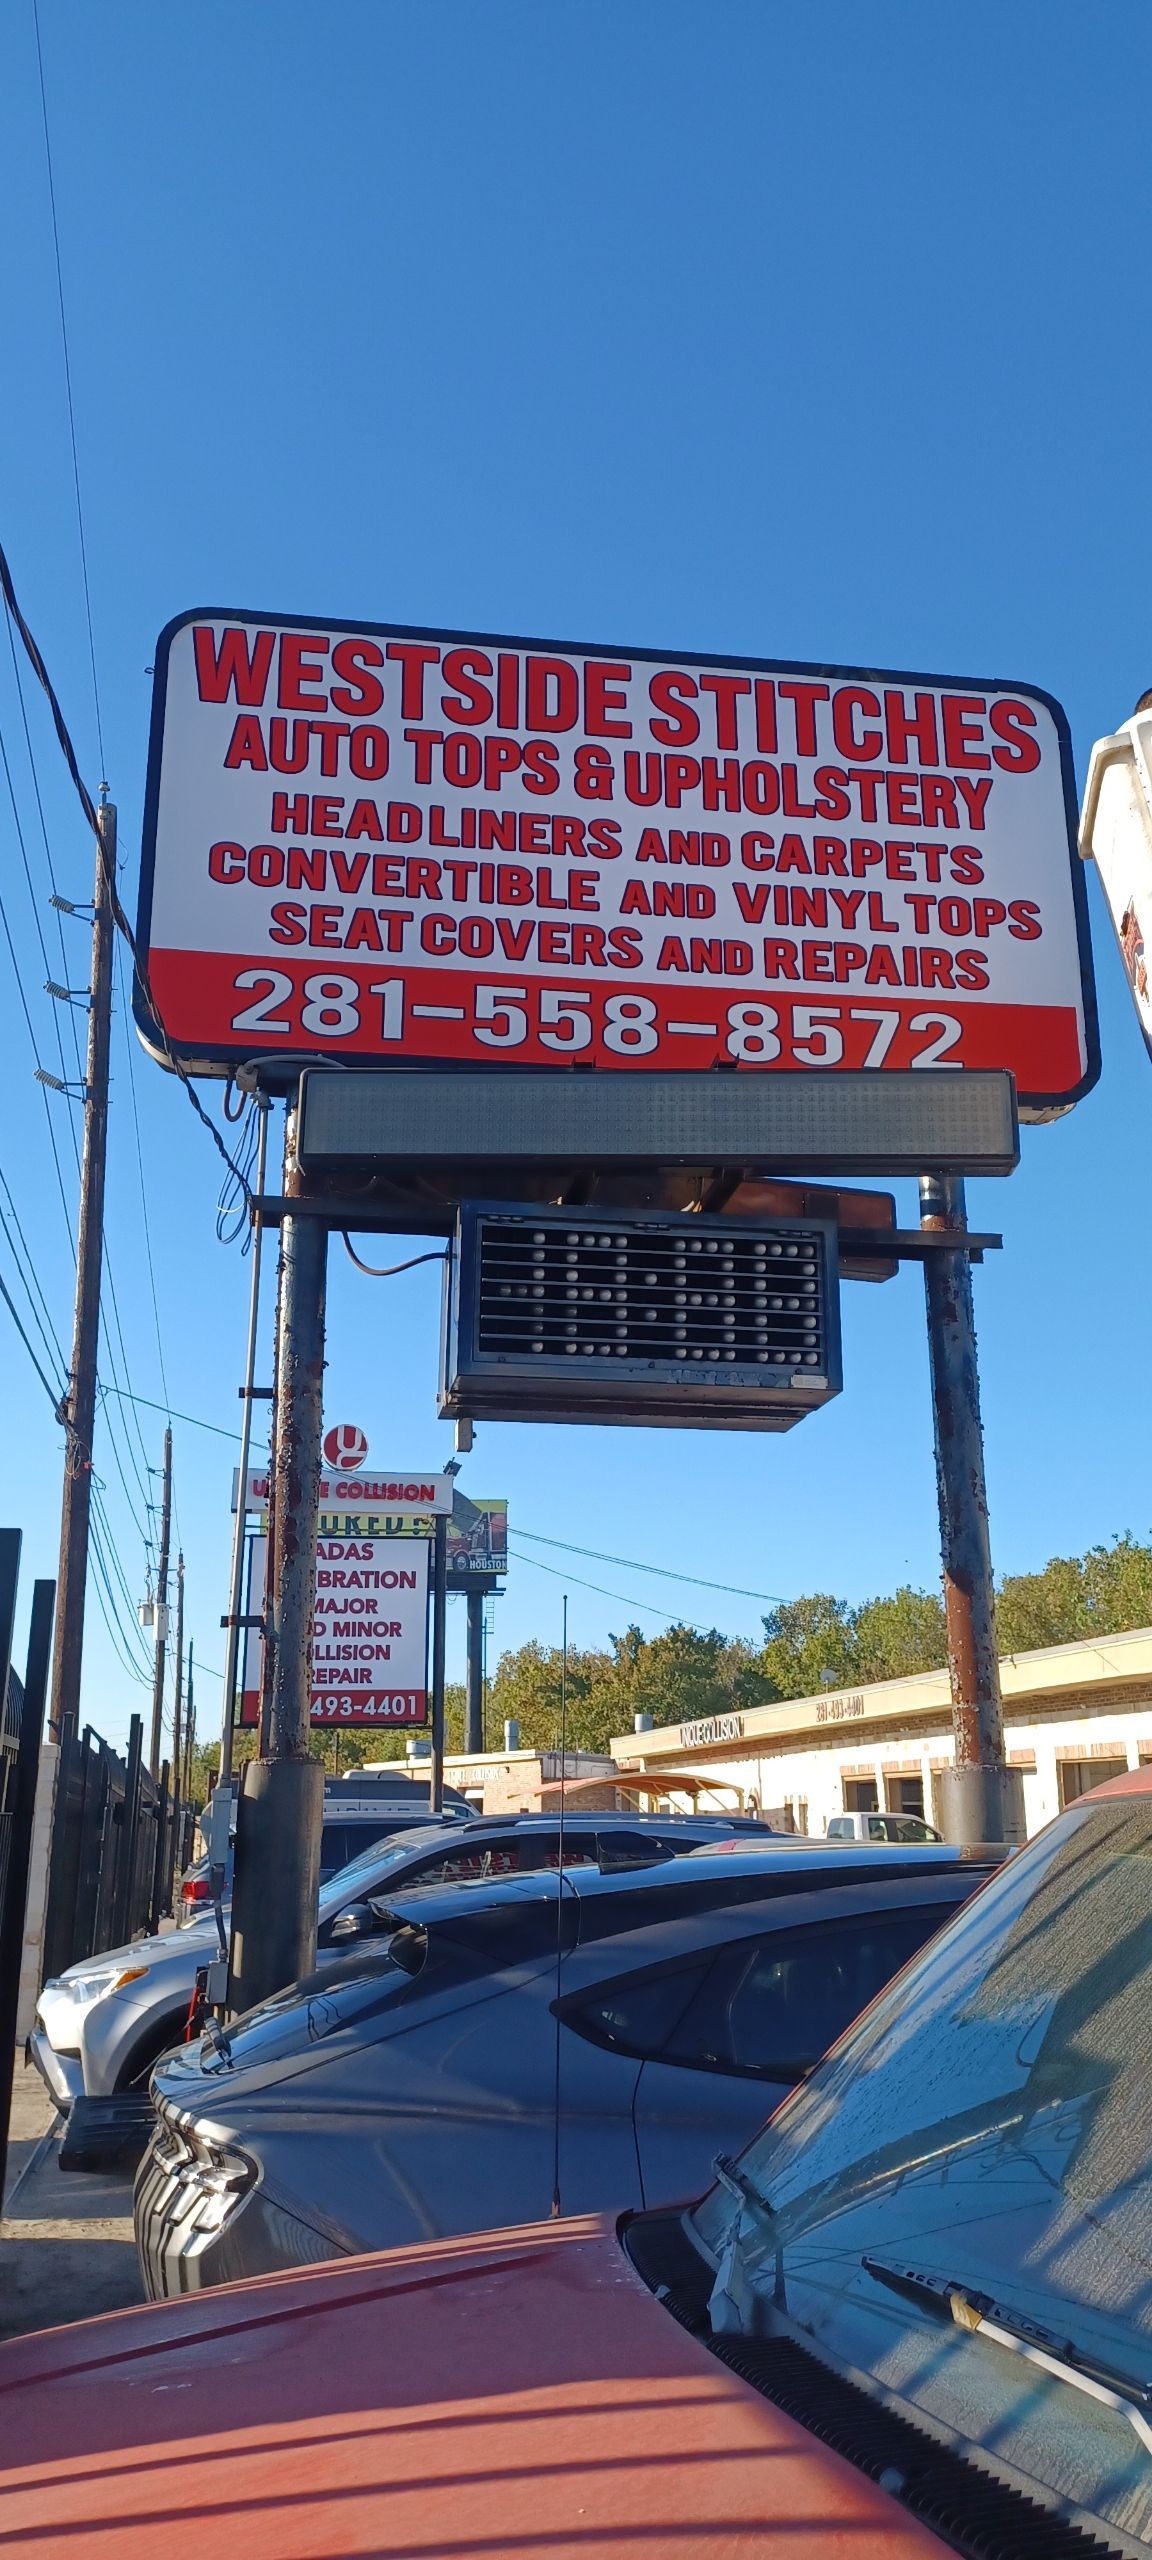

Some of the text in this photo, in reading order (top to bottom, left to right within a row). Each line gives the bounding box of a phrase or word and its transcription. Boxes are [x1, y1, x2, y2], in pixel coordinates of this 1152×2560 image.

[193, 626, 1041, 774] WESTSIDE STITCHES
[224, 714, 993, 830] AUTO TOPS & UPHOLSTERY
[636, 827, 731, 866] AND
[741, 831, 985, 885] CARPETS
[208, 841, 1042, 940] CONVERTIBLE AND VINYL TOPS
[269, 902, 990, 990] SEAT COVERS AND REPAIRS
[231, 968, 964, 1069] 281-558-8572
[336, 1481, 435, 1500] COLLISION
[469, 1560, 507, 1570] HOUSTON
[317, 1570, 417, 1589] BRATION
[333, 1622, 402, 1637] MINOR
[313, 1644, 391, 1661] LLISION
[312, 1667, 372, 1684] EPAIR
[310, 1695, 416, 1716] 493-4401
